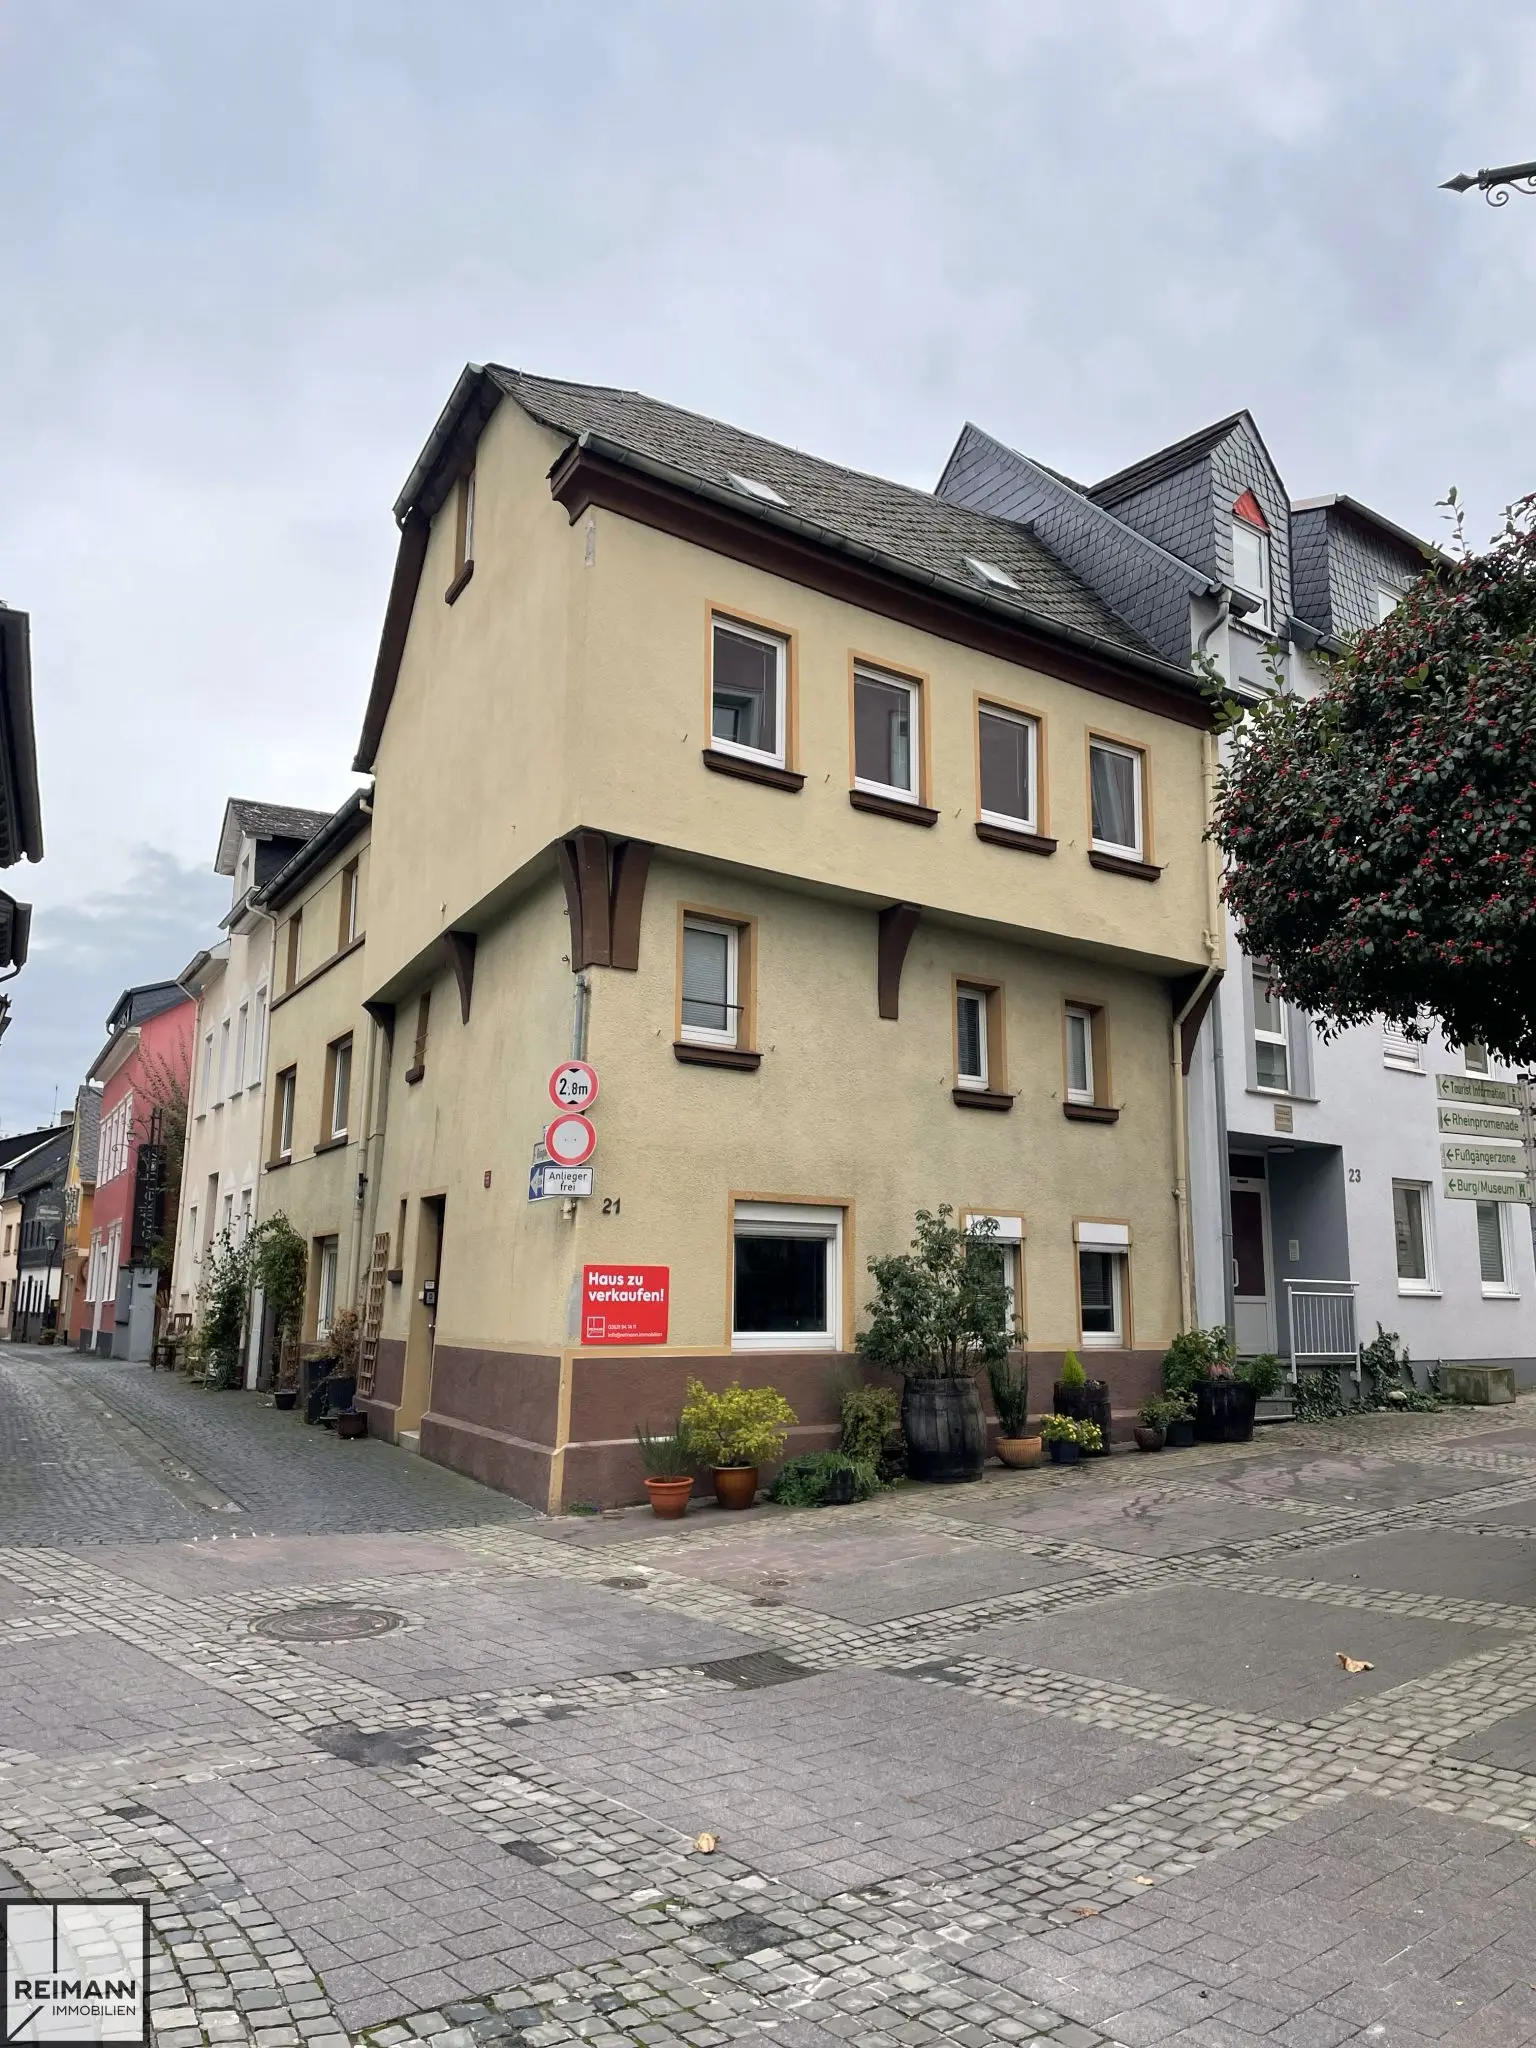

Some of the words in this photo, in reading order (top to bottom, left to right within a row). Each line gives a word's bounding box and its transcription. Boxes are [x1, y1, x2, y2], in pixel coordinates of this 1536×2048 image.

[1450, 1081, 1472, 1095] Tourist
[1472, 1084, 1506, 1100] Information
[1452, 1113, 1519, 1131] Rheinpromenade
[1454, 1148, 1516, 1165] Fußgängerzone
[549, 1172, 587, 1183] Anlieger
[1349, 1168, 1361, 1183] 23
[560, 1182, 576, 1192] frei
[602, 1198, 621, 1214] 21
[588, 1272, 624, 1285] Haus
[627, 1275, 643, 1285] zu
[588, 1288, 664, 1302] verkaufen!
